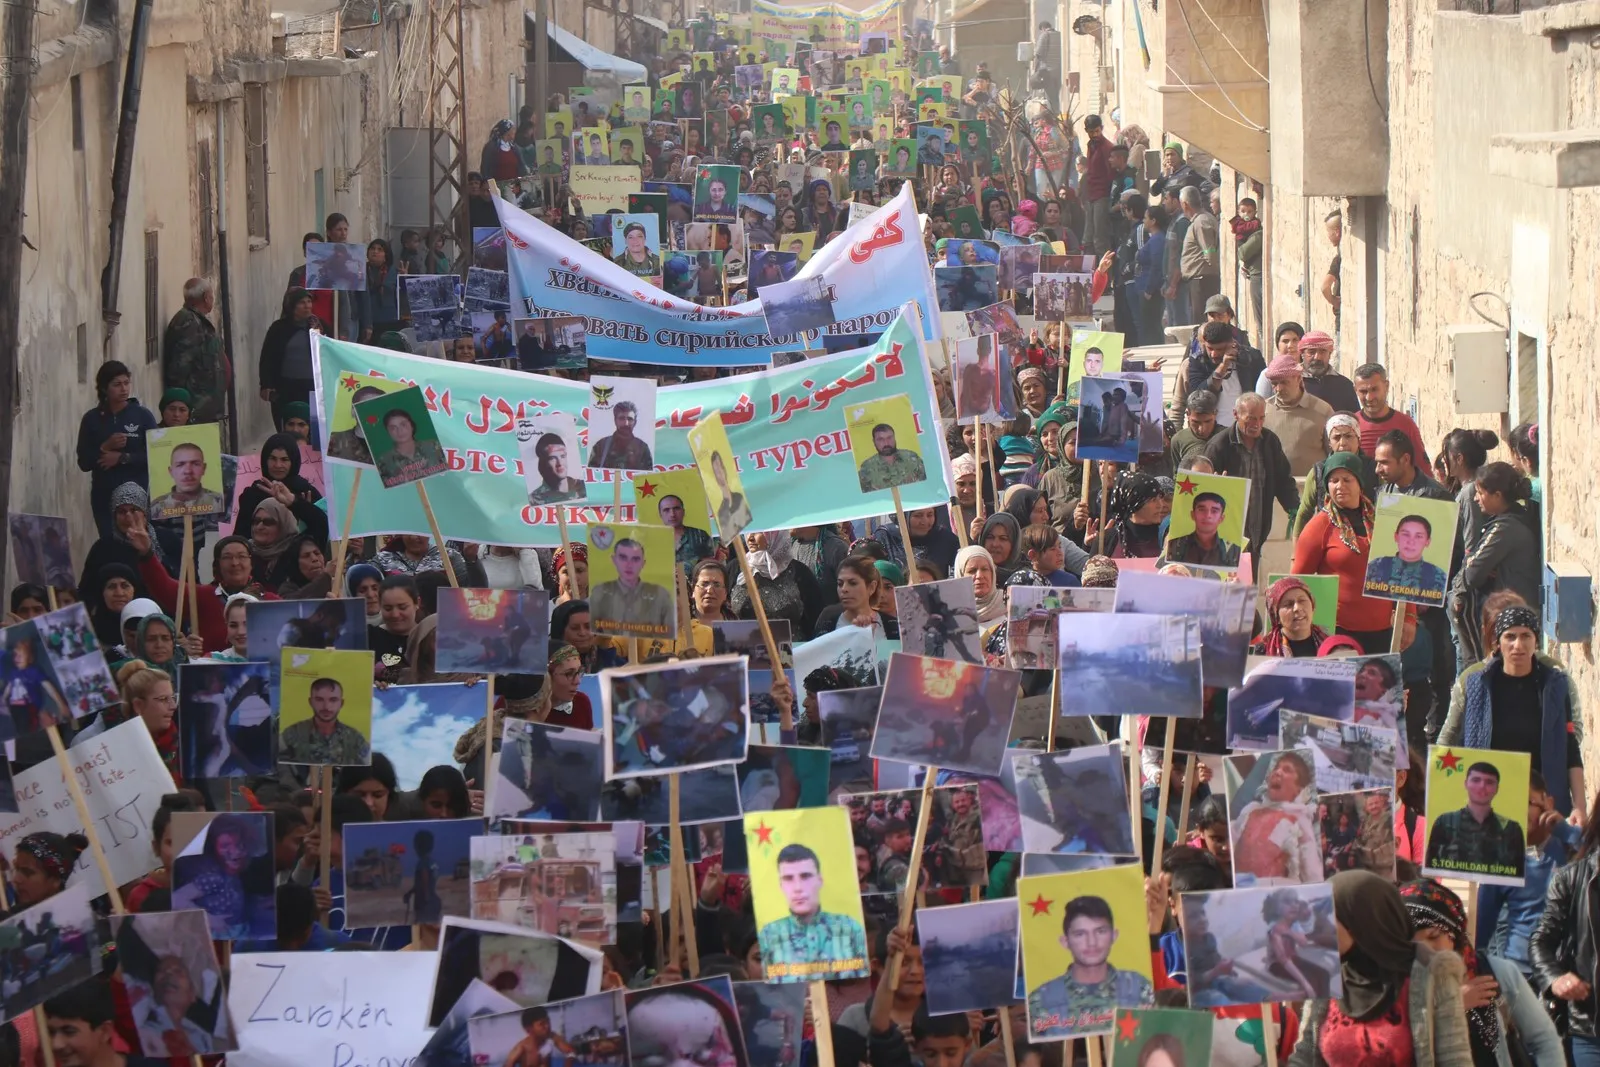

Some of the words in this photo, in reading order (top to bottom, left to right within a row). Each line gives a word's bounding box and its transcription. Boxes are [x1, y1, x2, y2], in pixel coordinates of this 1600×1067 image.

[824, 302, 924, 337] наро
[654, 392, 755, 428] شكاء
[1420, 589, 1442, 599] AMED
